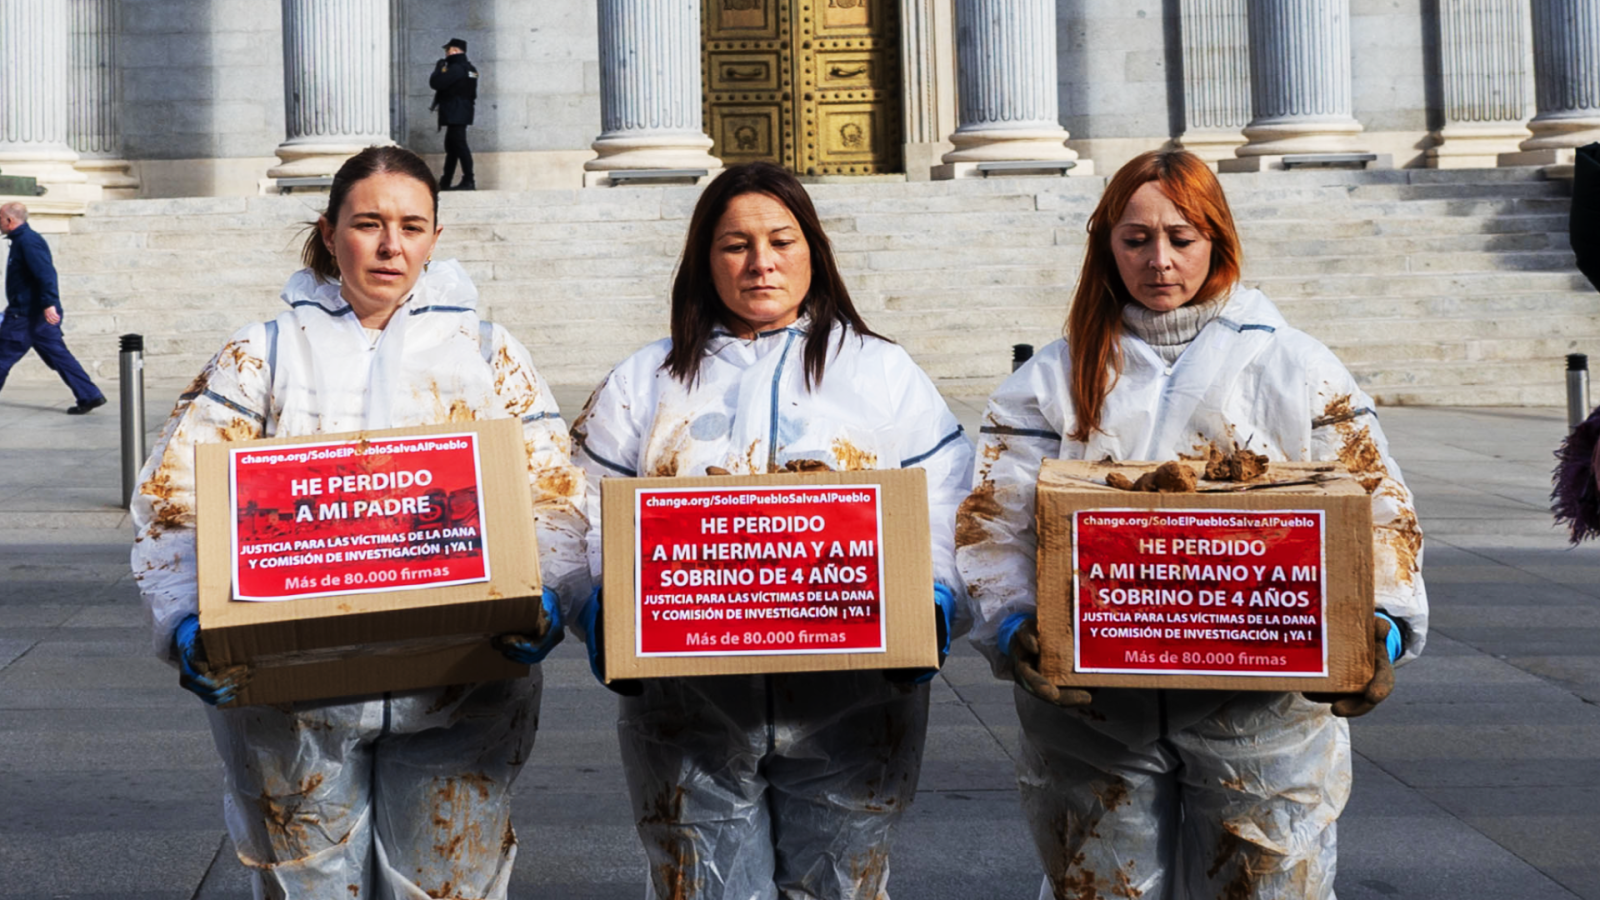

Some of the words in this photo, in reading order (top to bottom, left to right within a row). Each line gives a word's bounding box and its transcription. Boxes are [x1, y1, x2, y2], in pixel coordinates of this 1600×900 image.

[291, 478, 322, 496] HE
[328, 469, 432, 494] PERDIDO
[296, 505, 313, 522] A
[319, 502, 347, 520] MI
[354, 496, 430, 518] PADRE
[646, 492, 870, 509] change.org/SoloElPuebloSalvaAlPueblo
[701, 518, 728, 534] HE
[733, 516, 825, 533] PERDIDO
[1083, 516, 1314, 528] change.org/SoloElPuebloSalvaAlPueblo
[240, 542, 292, 555] JUSTICIA
[294, 539, 325, 550] PARA
[327, 537, 349, 548] LAS
[350, 533, 406, 546] VÍCTIMAS
[408, 531, 424, 541] DE
[426, 529, 441, 540] LA
[442, 527, 476, 538] DANA
[1140, 539, 1166, 554] HE
[1172, 539, 1266, 556] PERDIDO
[248, 559, 259, 569] Y
[260, 553, 323, 568] COMISIÓN
[326, 552, 343, 563] DE
[345, 543, 440, 561] INVESTIGACIÓN
[653, 545, 667, 560] A
[673, 544, 697, 560] MI
[703, 542, 807, 560] HERMANA
[811, 542, 824, 557] Y
[830, 541, 844, 557] A
[850, 540, 874, 556] MI
[285, 576, 317, 590] Más
[321, 574, 340, 586] de
[344, 570, 397, 585] 80.000
[400, 567, 449, 581] firmas
[661, 568, 754, 586] SOBRINO
[760, 568, 786, 584] DE
[791, 568, 804, 584] 4
[809, 564, 867, 583] AÑOS
[1090, 564, 1104, 579] A
[1110, 564, 1134, 579] MI
[1140, 564, 1248, 581] HERMANO
[1253, 566, 1266, 581] Y
[1272, 566, 1286, 581] A
[1292, 566, 1316, 581] MI
[644, 594, 693, 605] JUSTICIA
[696, 594, 725, 604] PARA
[728, 593, 749, 603] LAS
[751, 591, 804, 602] VÍCTIMAS
[808, 591, 822, 601] DE
[825, 591, 839, 601] LA
[842, 590, 874, 600] DANA
[1099, 589, 1193, 606] SOBRINO
[1200, 591, 1226, 606] DE
[1232, 591, 1244, 606] 4
[1250, 588, 1309, 607] AÑOS
[652, 610, 661, 620] Y
[662, 607, 723, 620] COMISIÓN
[726, 609, 742, 619] DE
[745, 605, 837, 619] INVESTIGACIÓN
[1083, 612, 1131, 622] JUSTICIA
[1134, 613, 1164, 623] PARA
[1167, 613, 1188, 623] LAS
[1190, 612, 1244, 624] VÍCTIMAS
[1248, 615, 1263, 624] DE
[1265, 615, 1280, 624] LA
[1283, 615, 1316, 625] DANA
[686, 632, 716, 645] Más
[721, 632, 739, 644] de
[743, 631, 795, 644] 80.000
[798, 630, 845, 642] firmas
[1090, 628, 1098, 637] Y
[1101, 627, 1162, 638] COMISIÓN
[1165, 629, 1180, 638] DE
[1184, 629, 1278, 640] INVESTIGACIÓN
[1125, 651, 1155, 663] Más
[1159, 651, 1178, 664] de
[1182, 652, 1234, 664] 80.000
[1238, 652, 1287, 665] firmas
